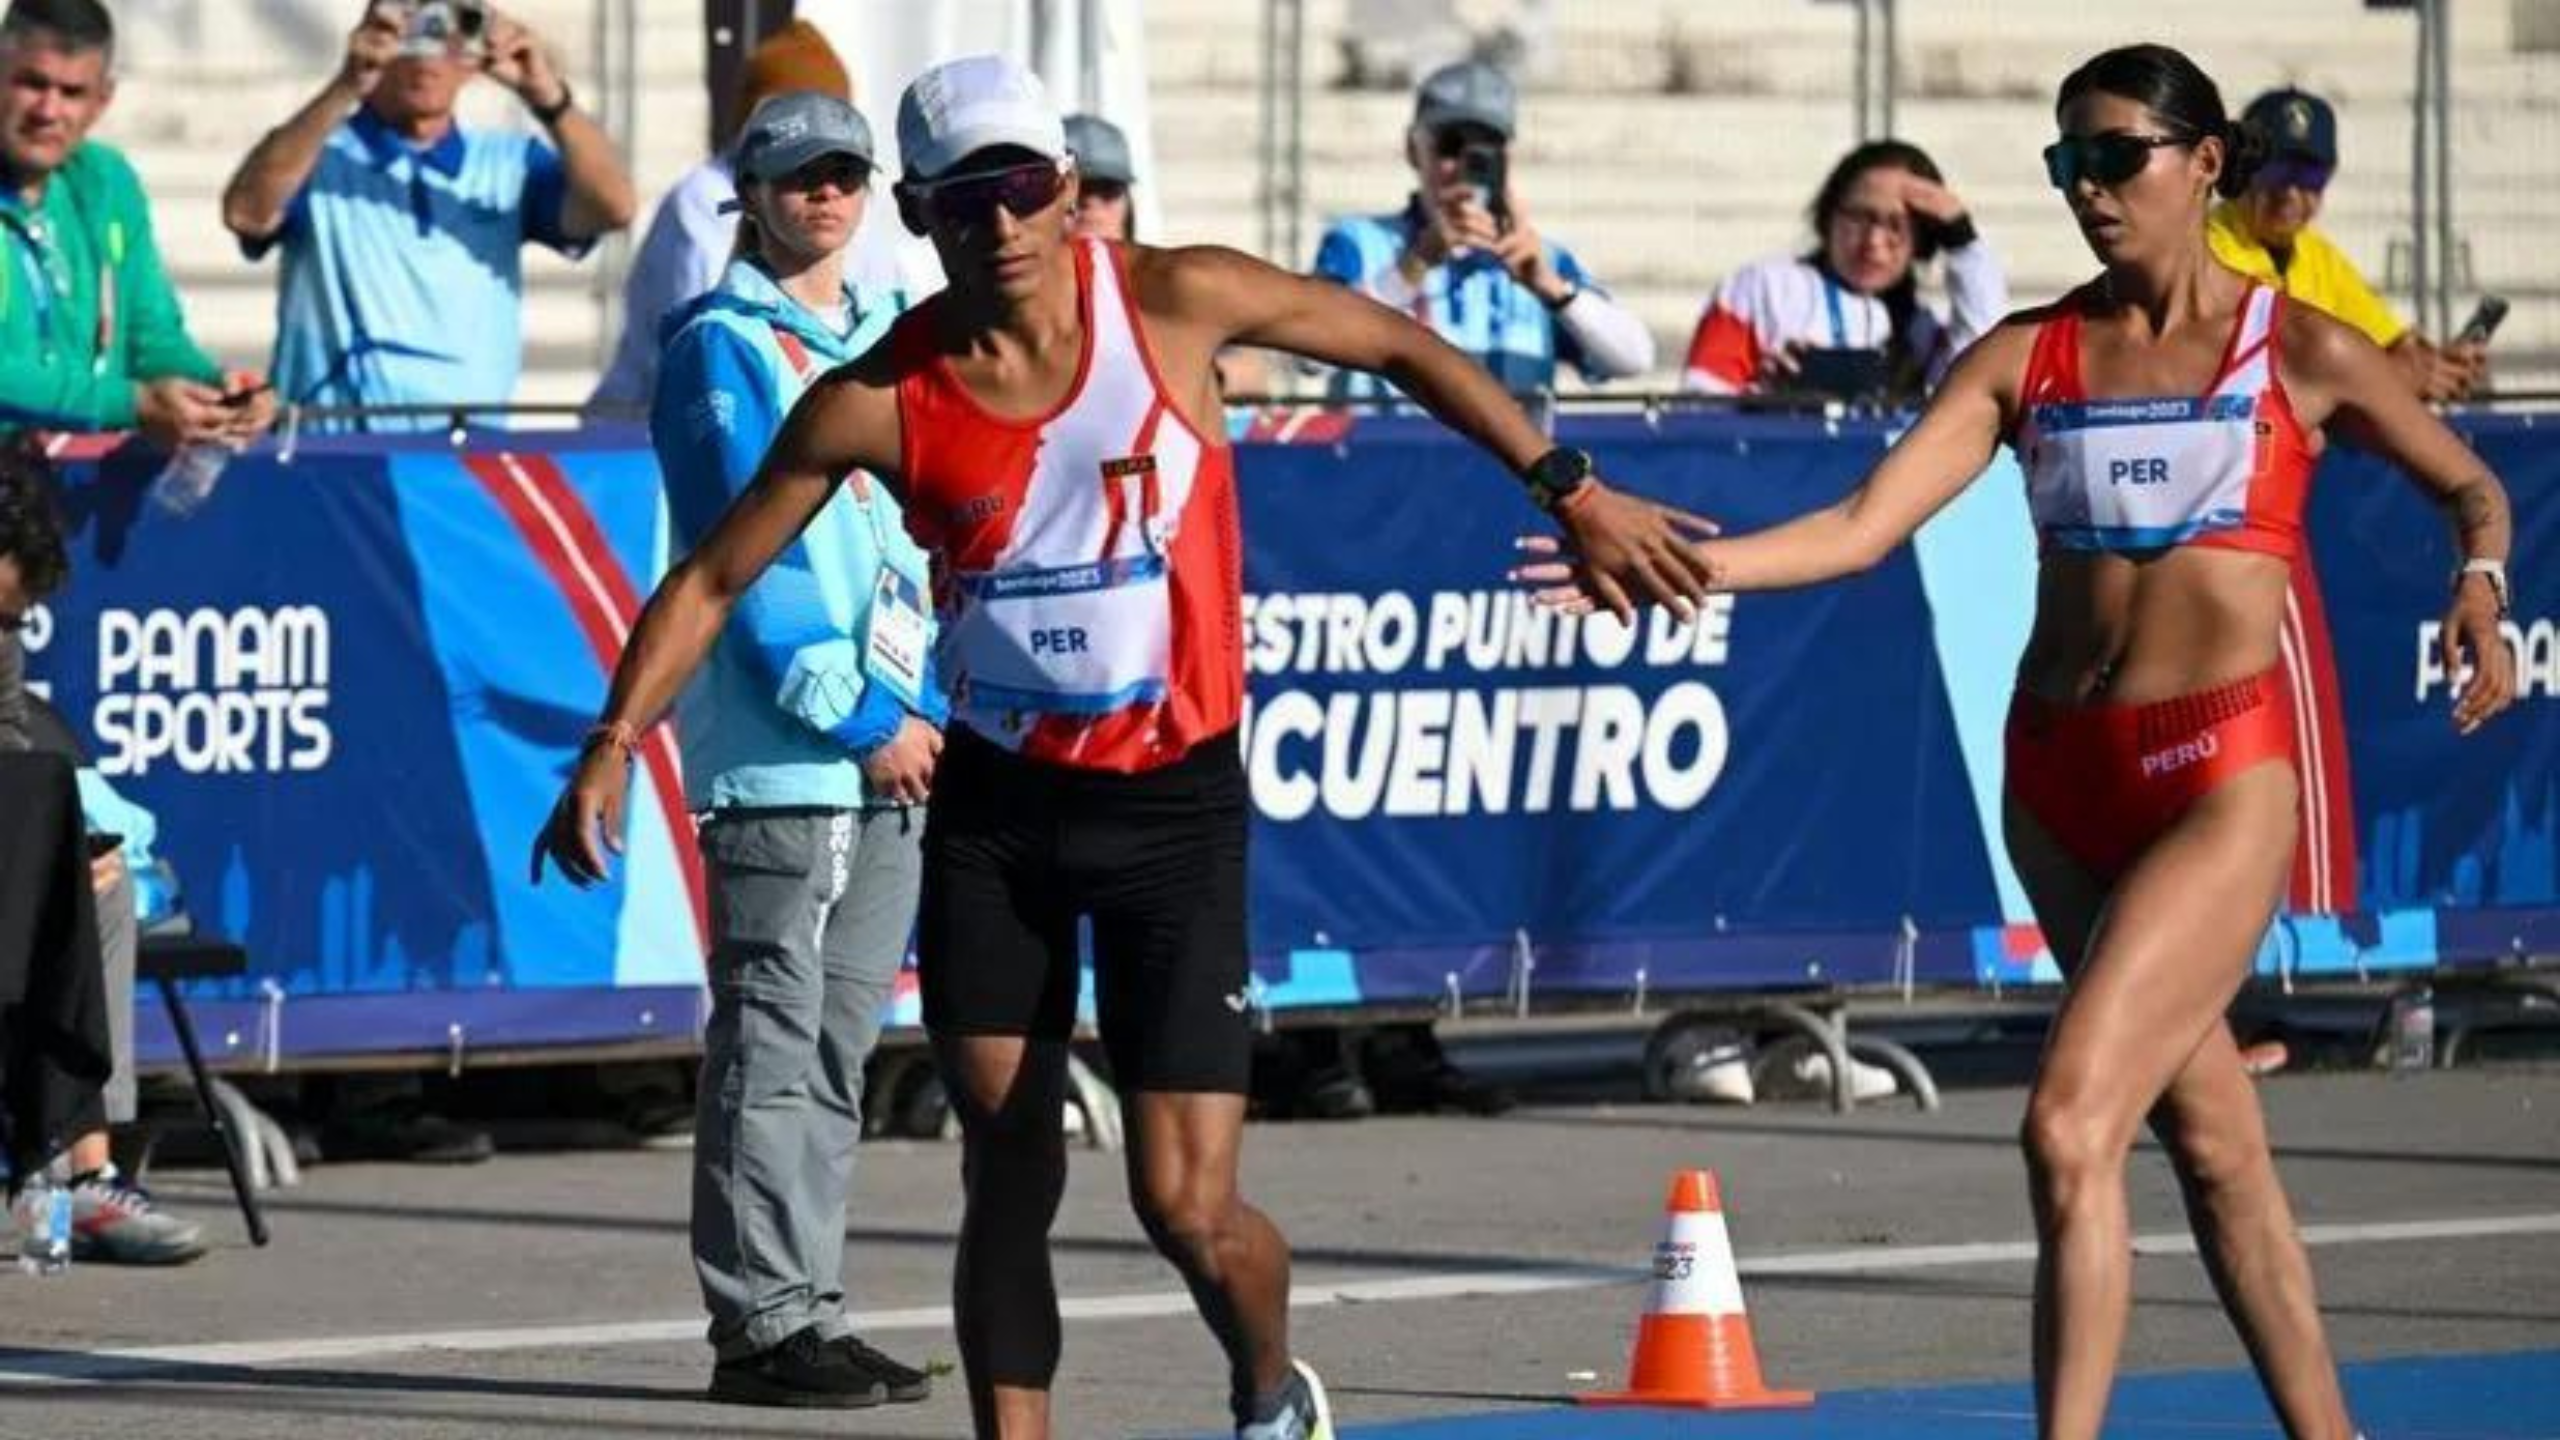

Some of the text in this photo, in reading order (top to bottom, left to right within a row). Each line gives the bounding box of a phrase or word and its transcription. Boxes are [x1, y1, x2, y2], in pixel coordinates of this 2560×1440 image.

[2110, 457, 2170, 485] PER
[98, 606, 330, 692] PANAM
[1030, 627, 1089, 654] PER
[1425, 590, 1638, 671] PUNTO
[1646, 593, 1735, 666] DE
[93, 688, 332, 777] SPORTS
[1239, 682, 1728, 820] CUENTRO
